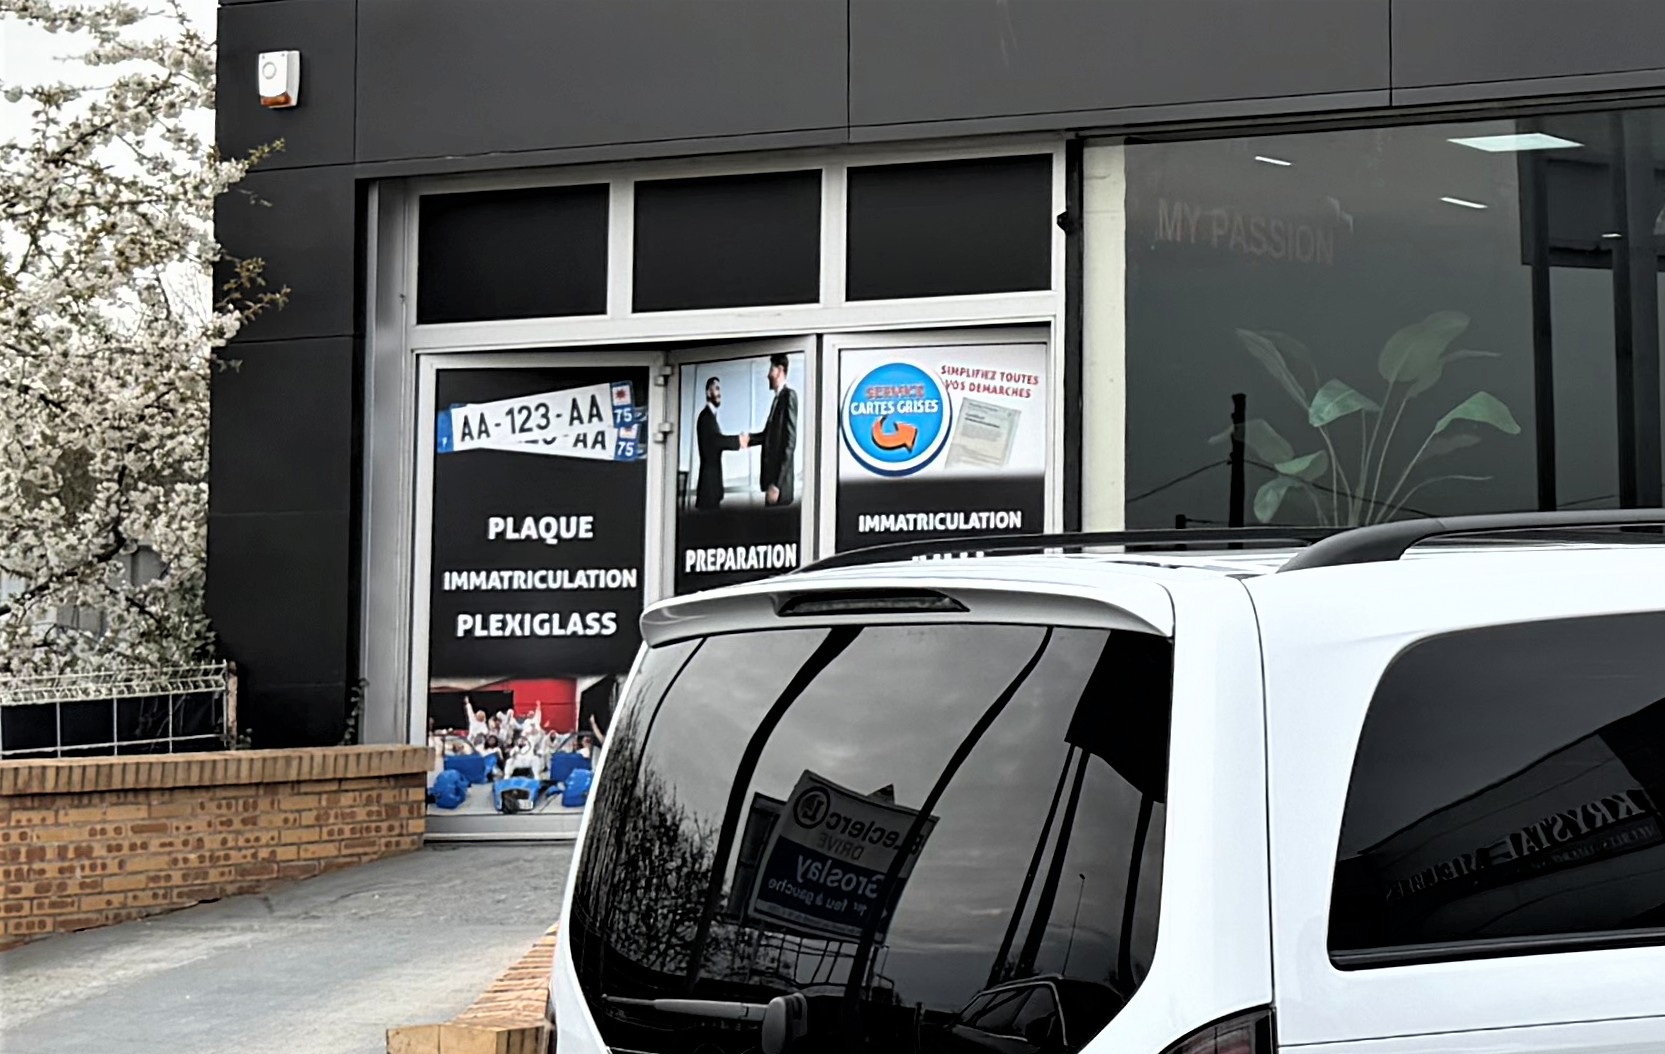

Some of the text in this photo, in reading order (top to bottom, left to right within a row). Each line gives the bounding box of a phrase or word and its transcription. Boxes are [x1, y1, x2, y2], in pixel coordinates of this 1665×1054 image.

[1156, 197, 1335, 266] MY PASSION
[940, 364, 1040, 386] SIMPLIFIEZ TOUTES
[944, 379, 1032, 399] VOS DEMARCHES
[614, 407, 633, 423] 75
[850, 398, 939, 416] CARTES GRISES
[617, 441, 635, 457] 75
[487, 516, 594, 543] PLAQUE
[858, 511, 1022, 532] IMMATRICULATION
[685, 544, 797, 573] PREPARATION
[443, 568, 637, 591] IMMATRICULATION
[456, 612, 618, 639] PLEXIGLASS
